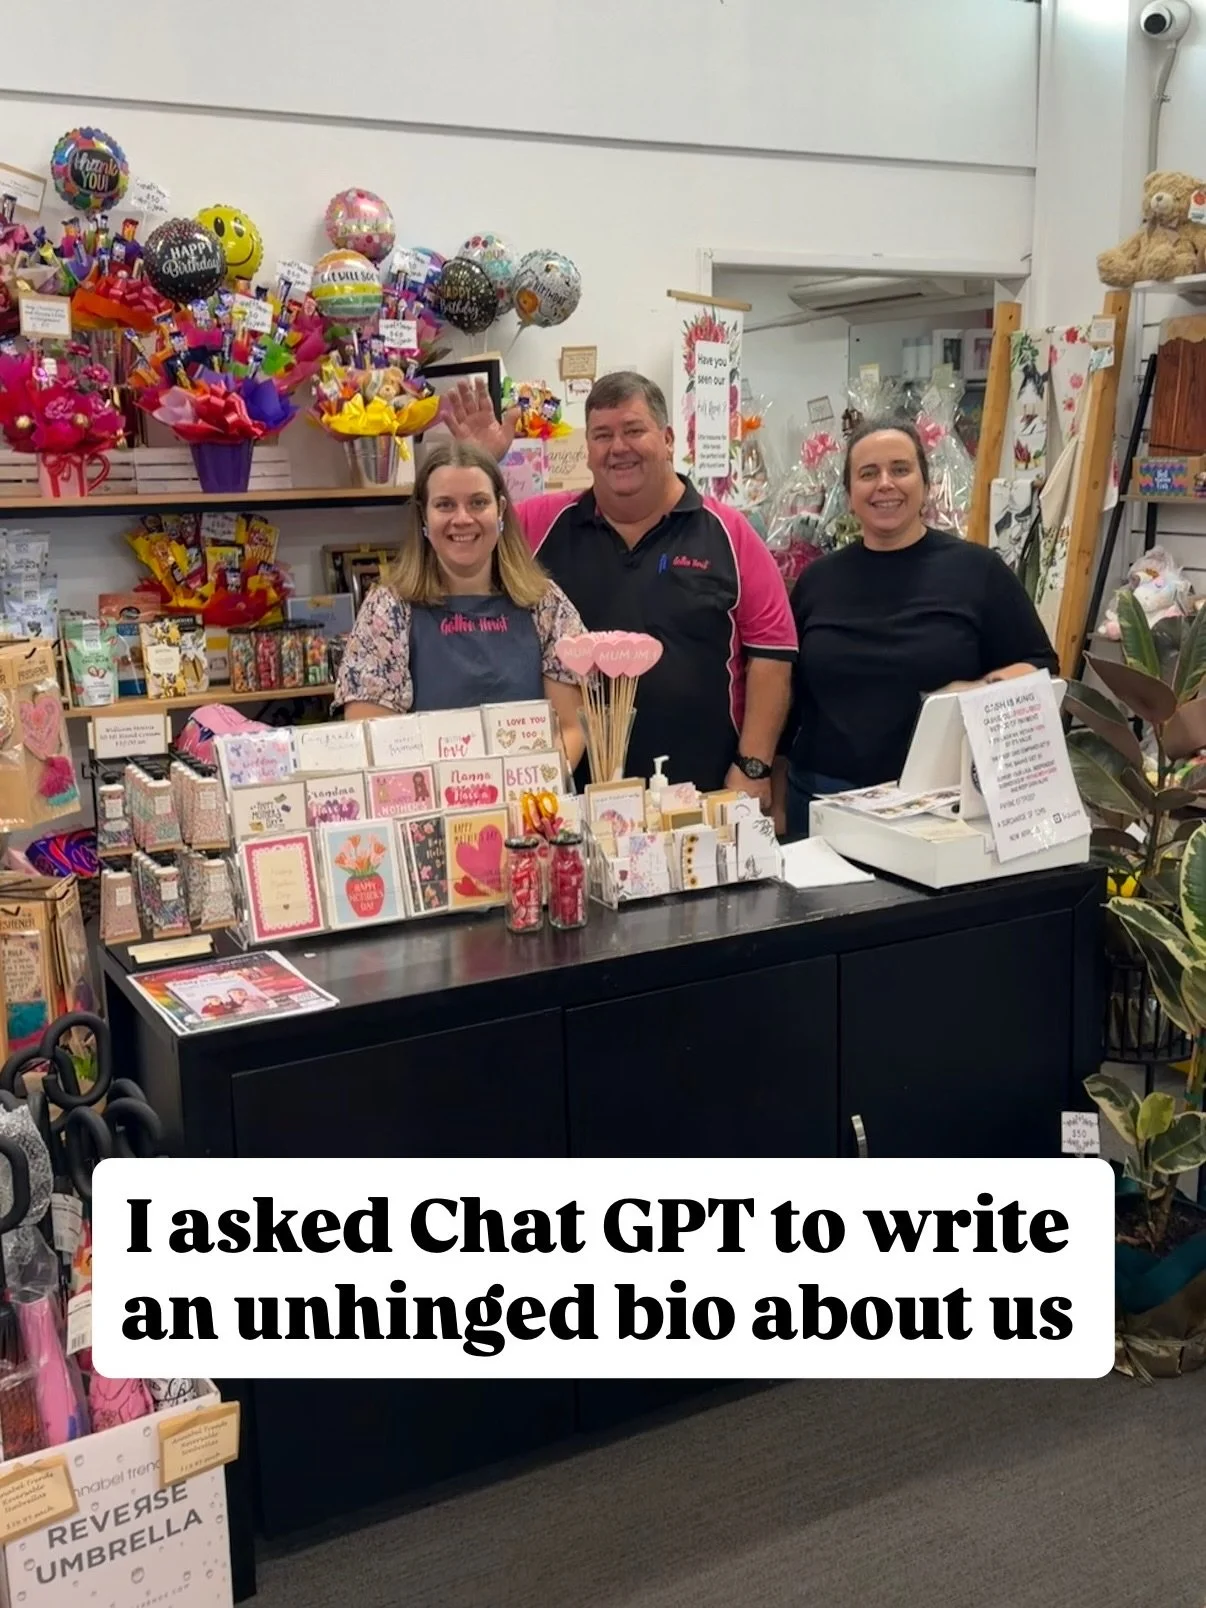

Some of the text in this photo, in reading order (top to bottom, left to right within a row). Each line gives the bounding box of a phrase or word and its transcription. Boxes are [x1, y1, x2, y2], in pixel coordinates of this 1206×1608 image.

[81, 171, 109, 192] YOU!
[169, 240, 214, 260] HAPPY
[161, 247, 220, 278] Birthday
[338, 271, 360, 281] WELL
[697, 355, 728, 368] Have you
[697, 375, 726, 386] seen our
[599, 651, 630, 663] MUM
[506, 717, 526, 726] LOVE
[529, 716, 547, 725] YOU
[450, 769, 493, 785] Nanna
[505, 766, 539, 787] BEST
[1072, 1129, 1087, 1138] $50
[75, 1471, 124, 1499] nnabel
[36, 1508, 203, 1585] UMBRELLA
